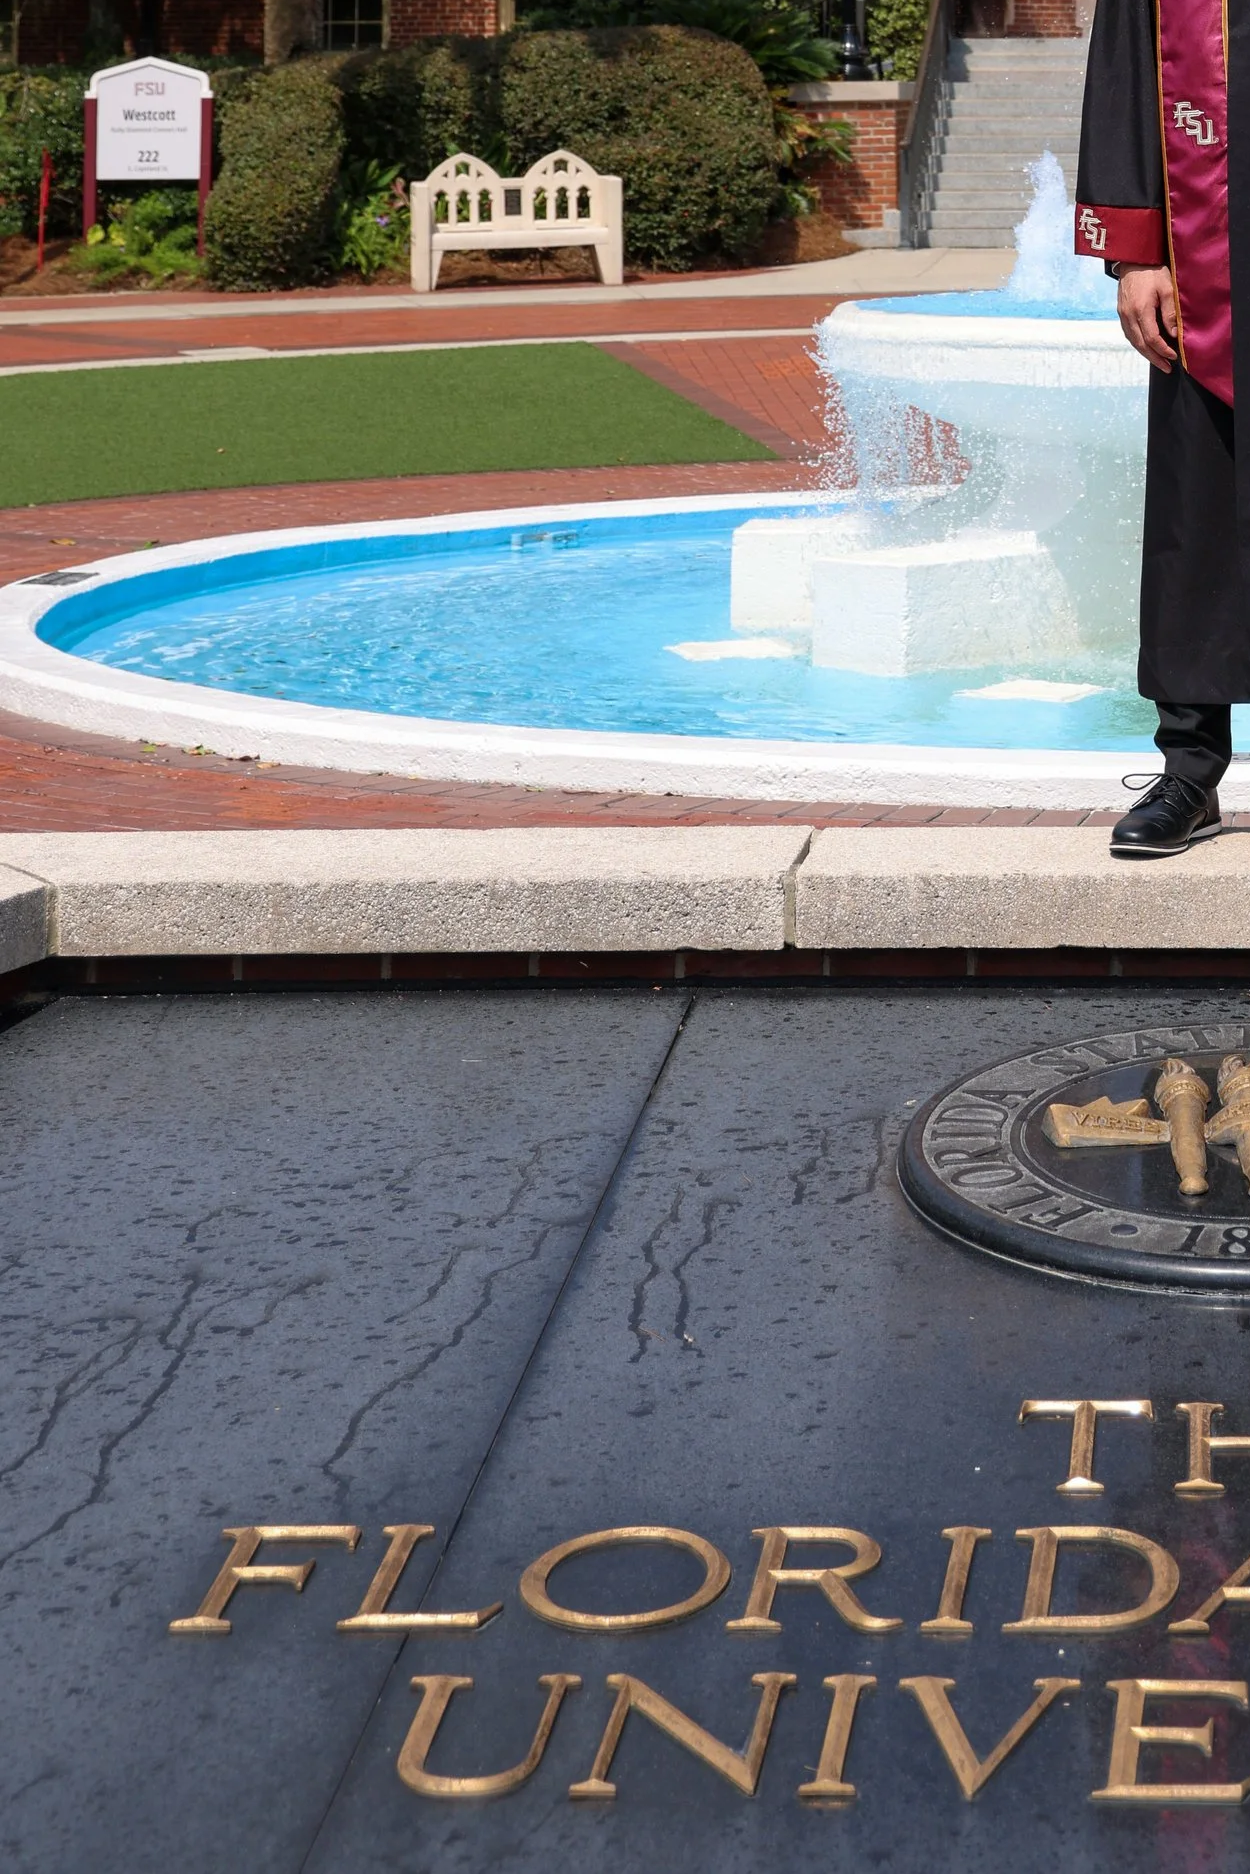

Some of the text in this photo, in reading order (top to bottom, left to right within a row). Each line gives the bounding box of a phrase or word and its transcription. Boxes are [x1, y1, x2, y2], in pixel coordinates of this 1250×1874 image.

[134, 82, 165, 96] FSU
[122, 109, 176, 121] Westcott
[1173, 101, 1214, 146] FSU
[137, 150, 159, 163] 222
[1079, 208, 1106, 251] FSU
[931, 1088, 1104, 1232] FLORIDA
